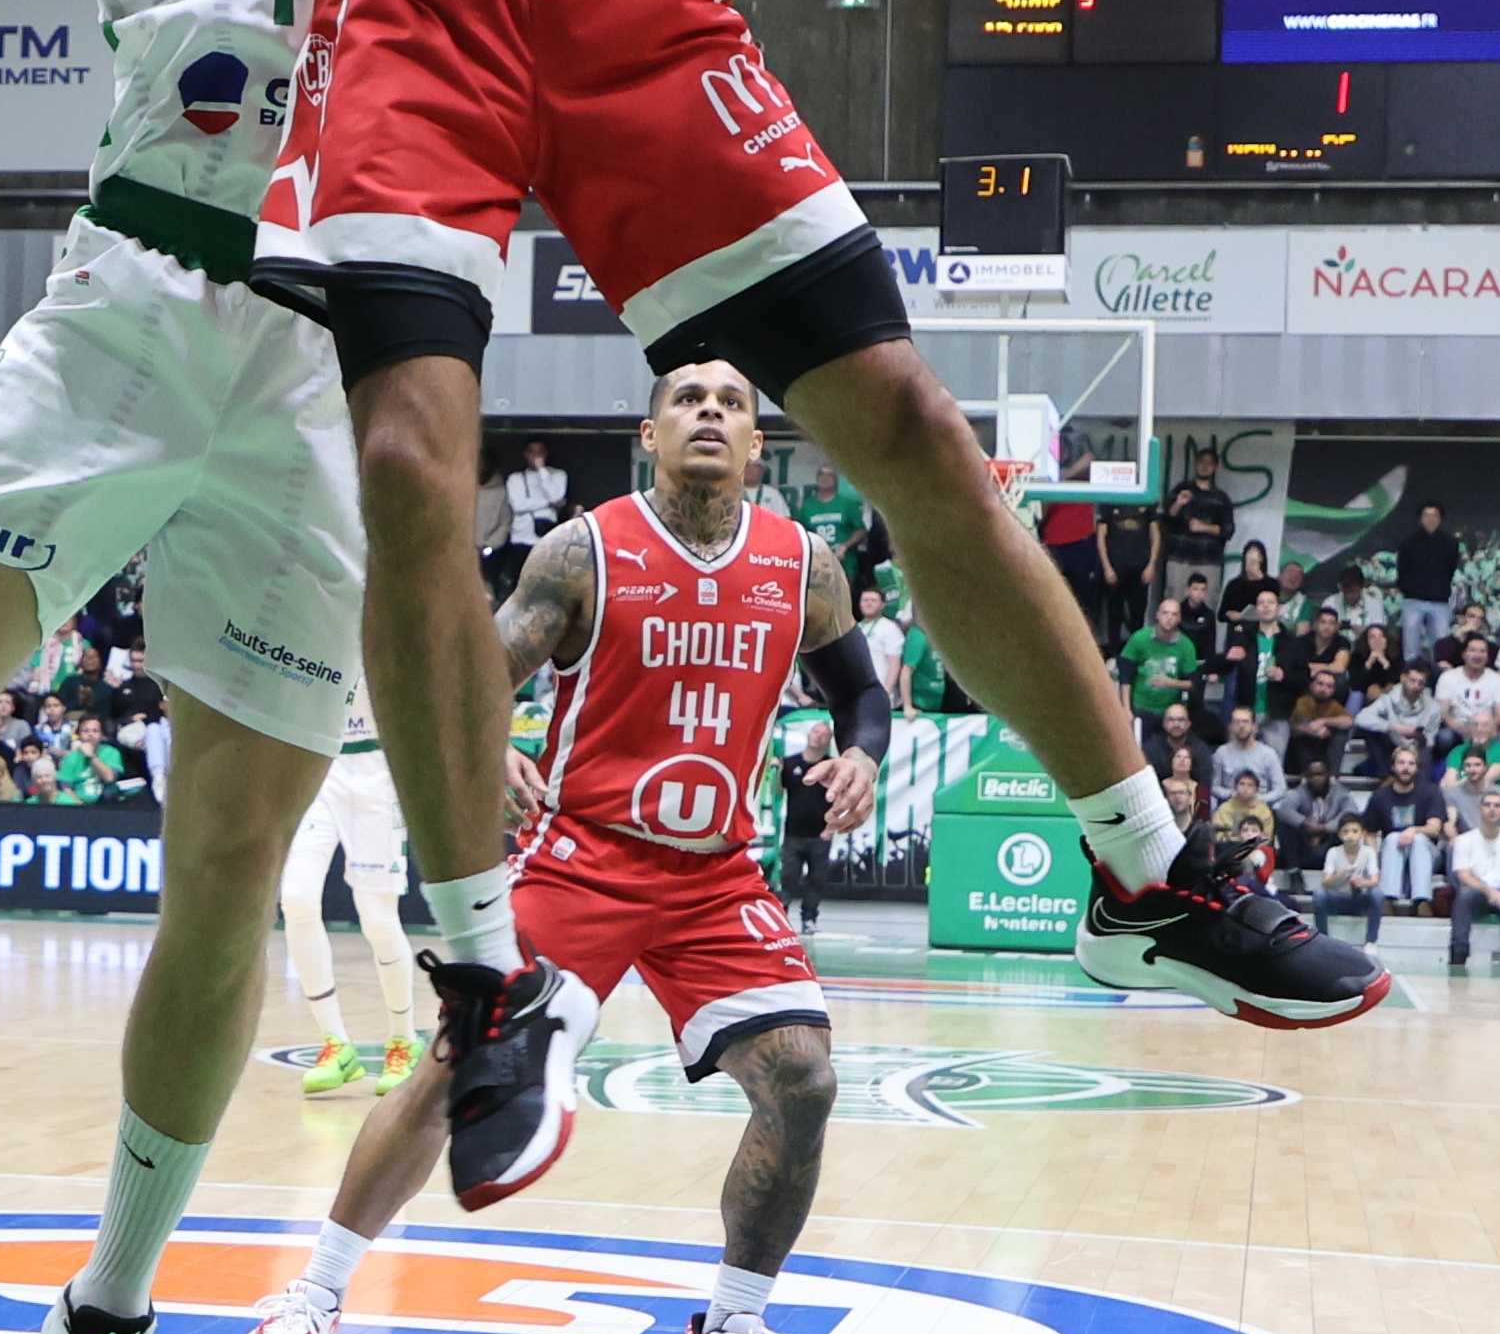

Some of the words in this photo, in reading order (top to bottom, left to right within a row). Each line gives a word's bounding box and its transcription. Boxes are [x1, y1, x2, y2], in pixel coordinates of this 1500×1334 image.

[1336, 71, 1350, 114] 1
[977, 166, 1031, 197] 3.1
[975, 263, 1055, 278] IMMOBEL
[224, 618, 343, 685] hauts-de-seine
[642, 616, 772, 674] CHOLET
[668, 680, 732, 746] 44
[984, 777, 1049, 798] Betclic
[968, 891, 1078, 915] E.Leclerc
[983, 914, 1068, 934] Nanterre
